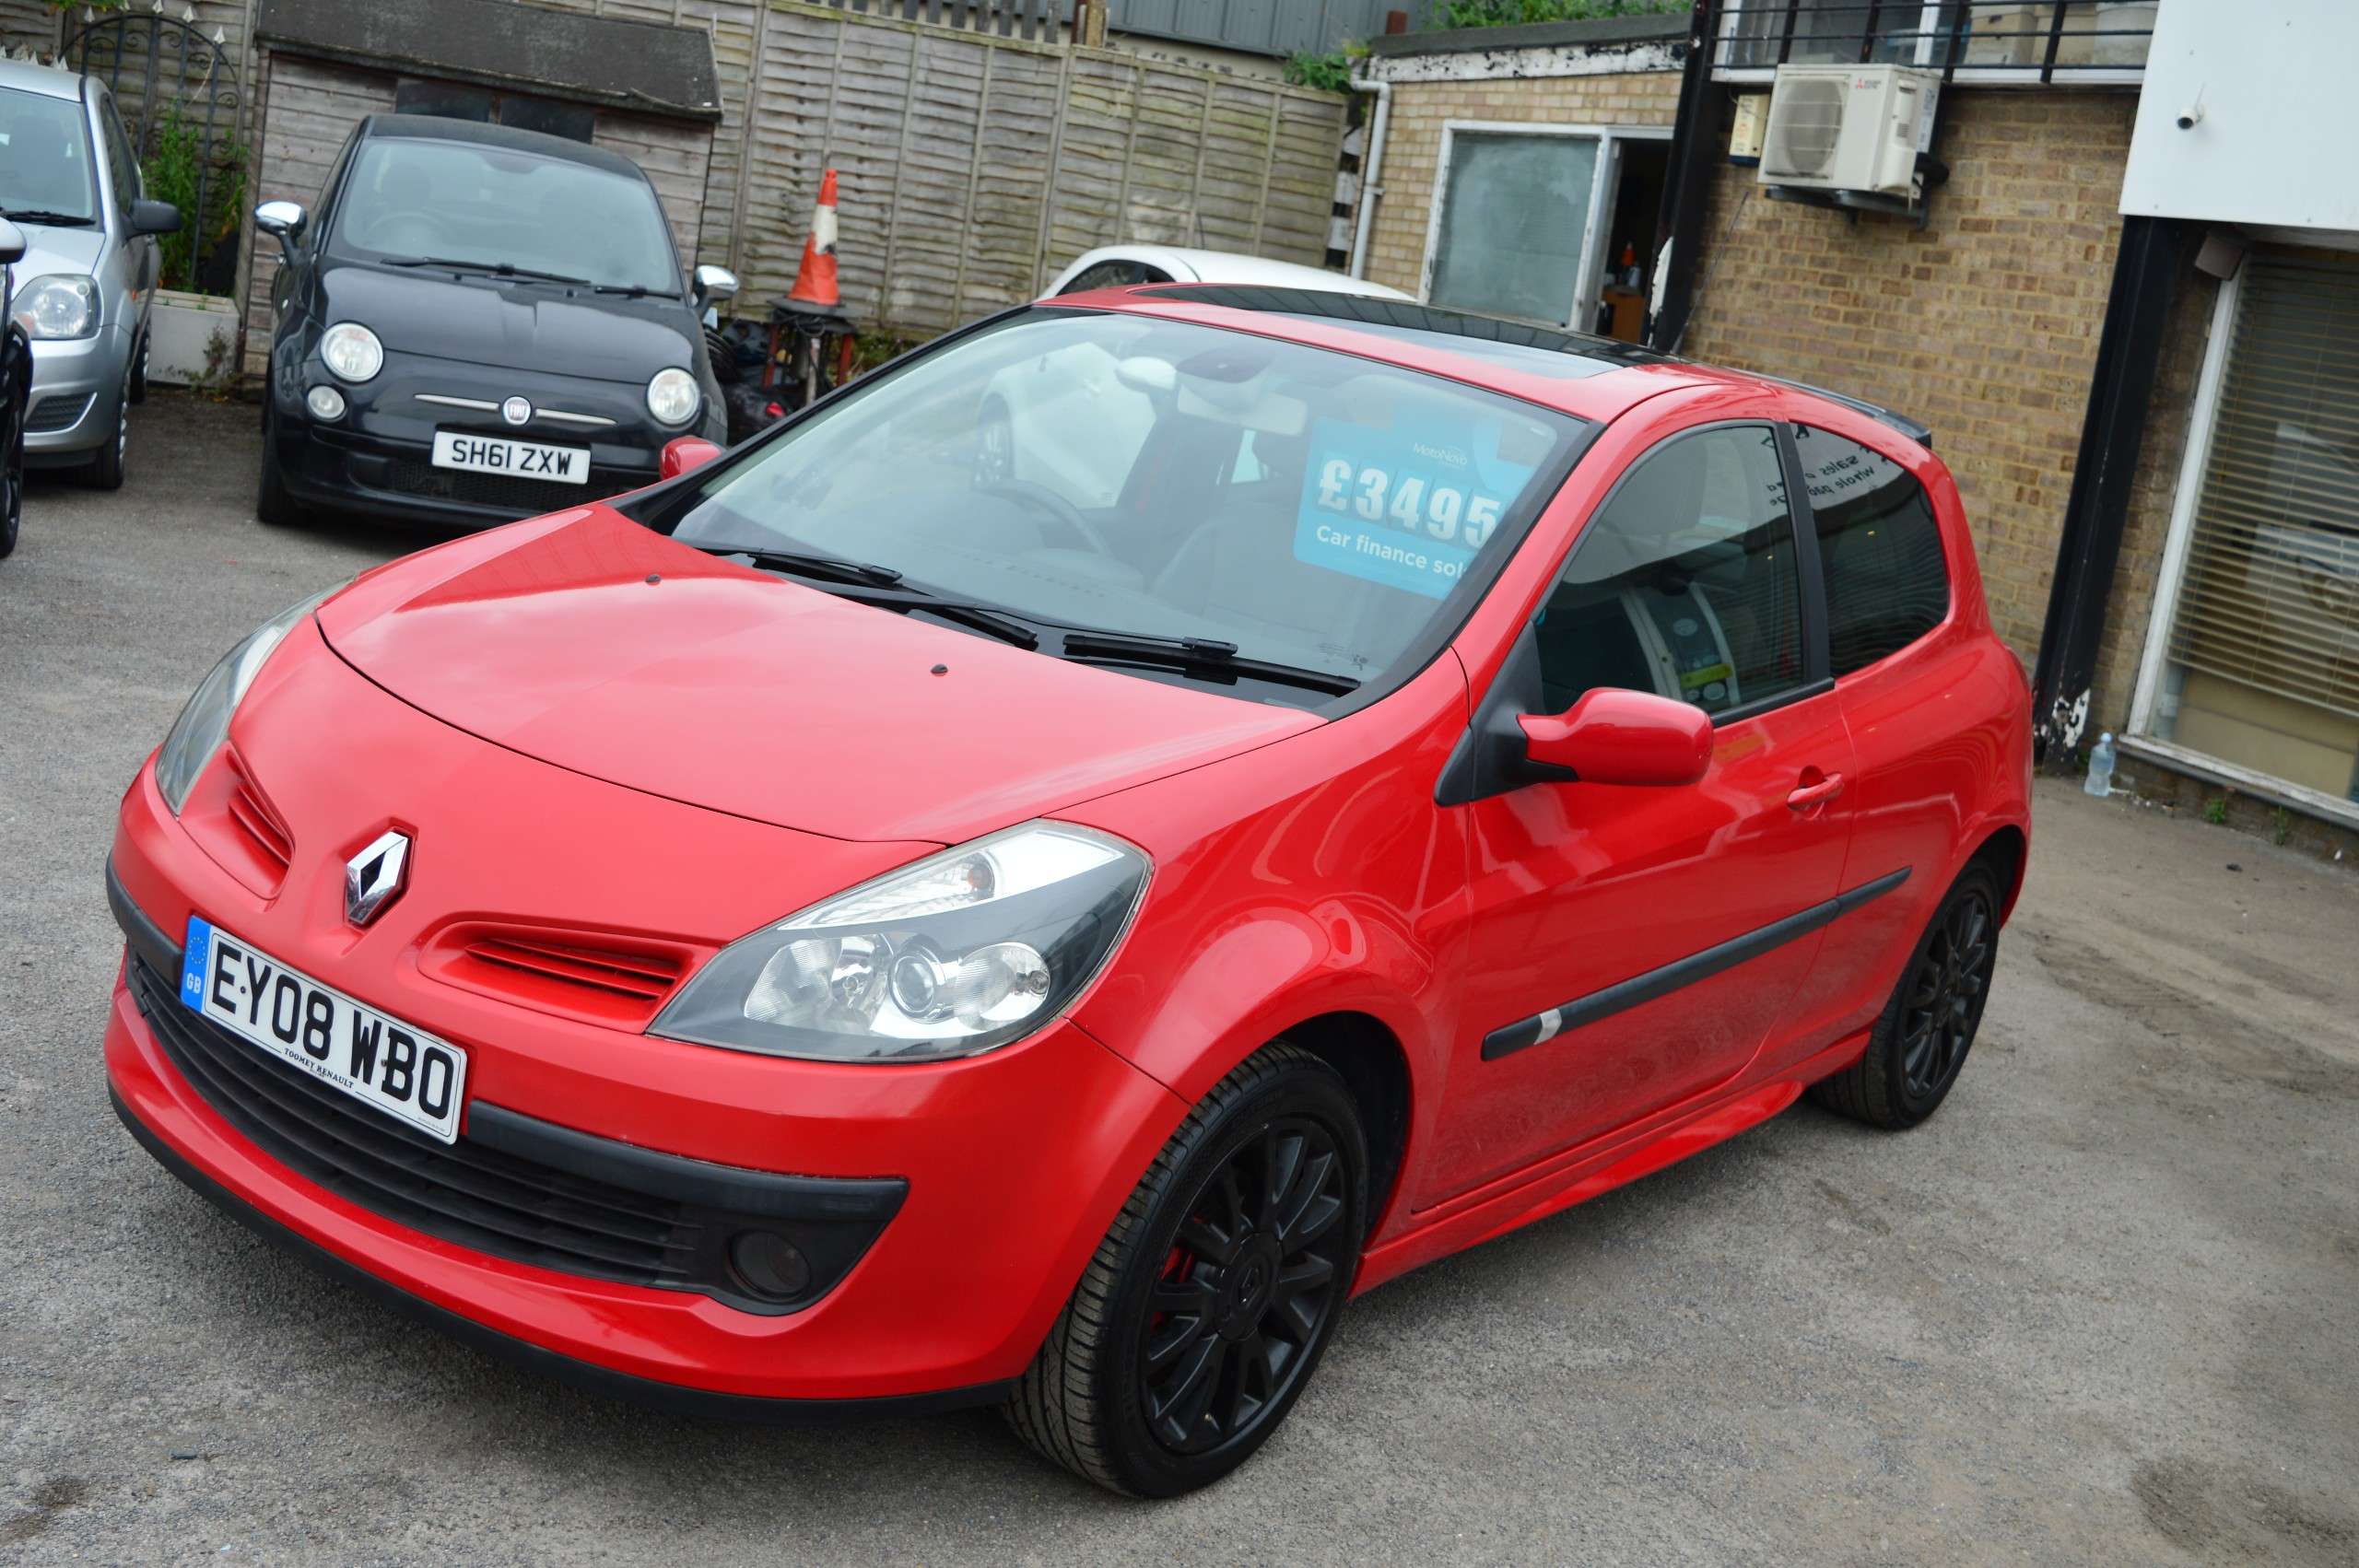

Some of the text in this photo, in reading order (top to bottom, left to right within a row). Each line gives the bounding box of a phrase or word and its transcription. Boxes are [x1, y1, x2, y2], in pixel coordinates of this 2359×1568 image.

[452, 439, 572, 475] SH61 ZXW
[1318, 460, 1501, 549] £3495
[1316, 525, 1468, 579] Car finance sol
[186, 972, 202, 994] GB
[211, 941, 454, 1120] EY08 WBO
[285, 1047, 316, 1070] TOOMEY
[316, 1065, 355, 1089] RENAULT
